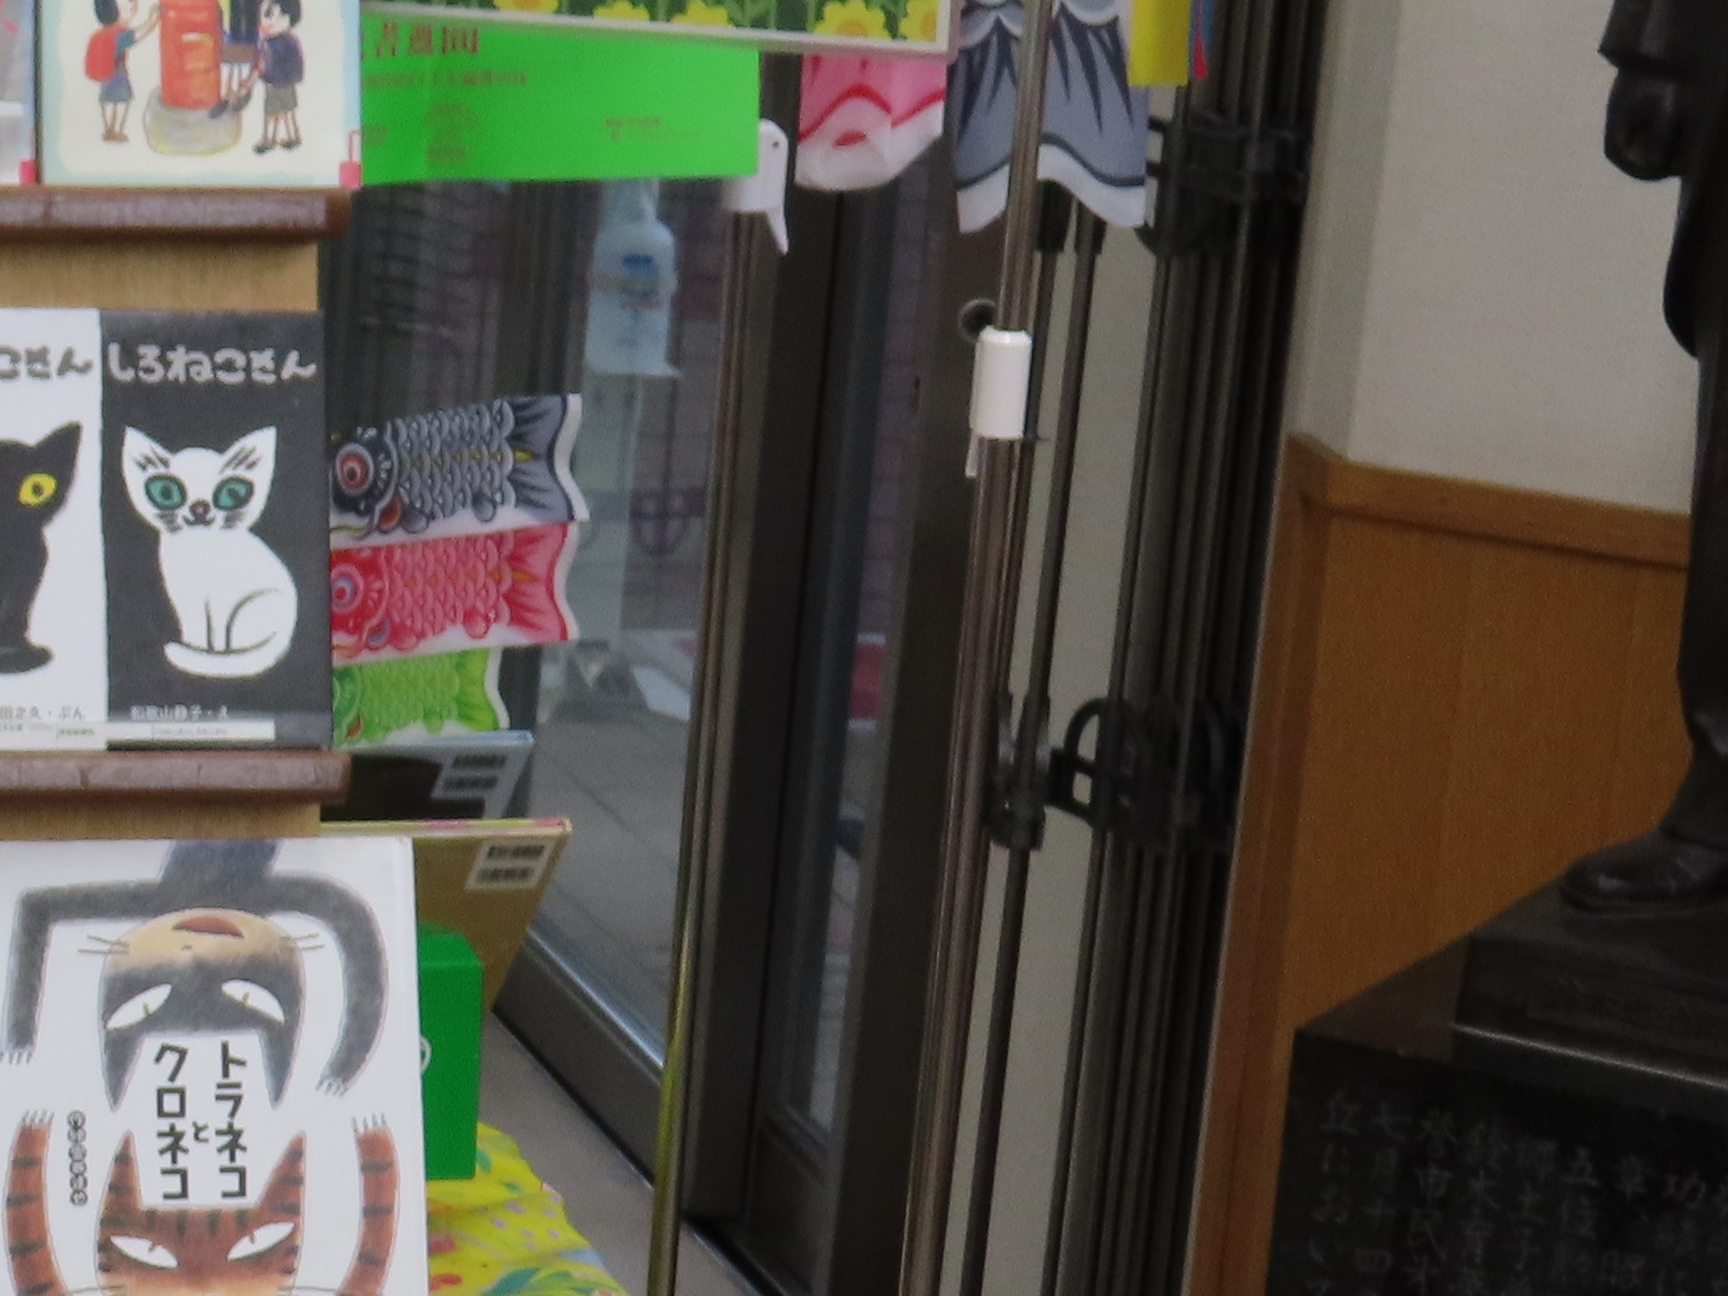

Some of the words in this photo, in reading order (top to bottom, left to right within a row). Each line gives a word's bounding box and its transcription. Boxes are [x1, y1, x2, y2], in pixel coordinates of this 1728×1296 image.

[107, 343, 318, 386] しろねこさん
[154, 1042, 190, 1202] クロネコ
[192, 1120, 210, 1144] と
[214, 1039, 249, 1199] トラネコ
